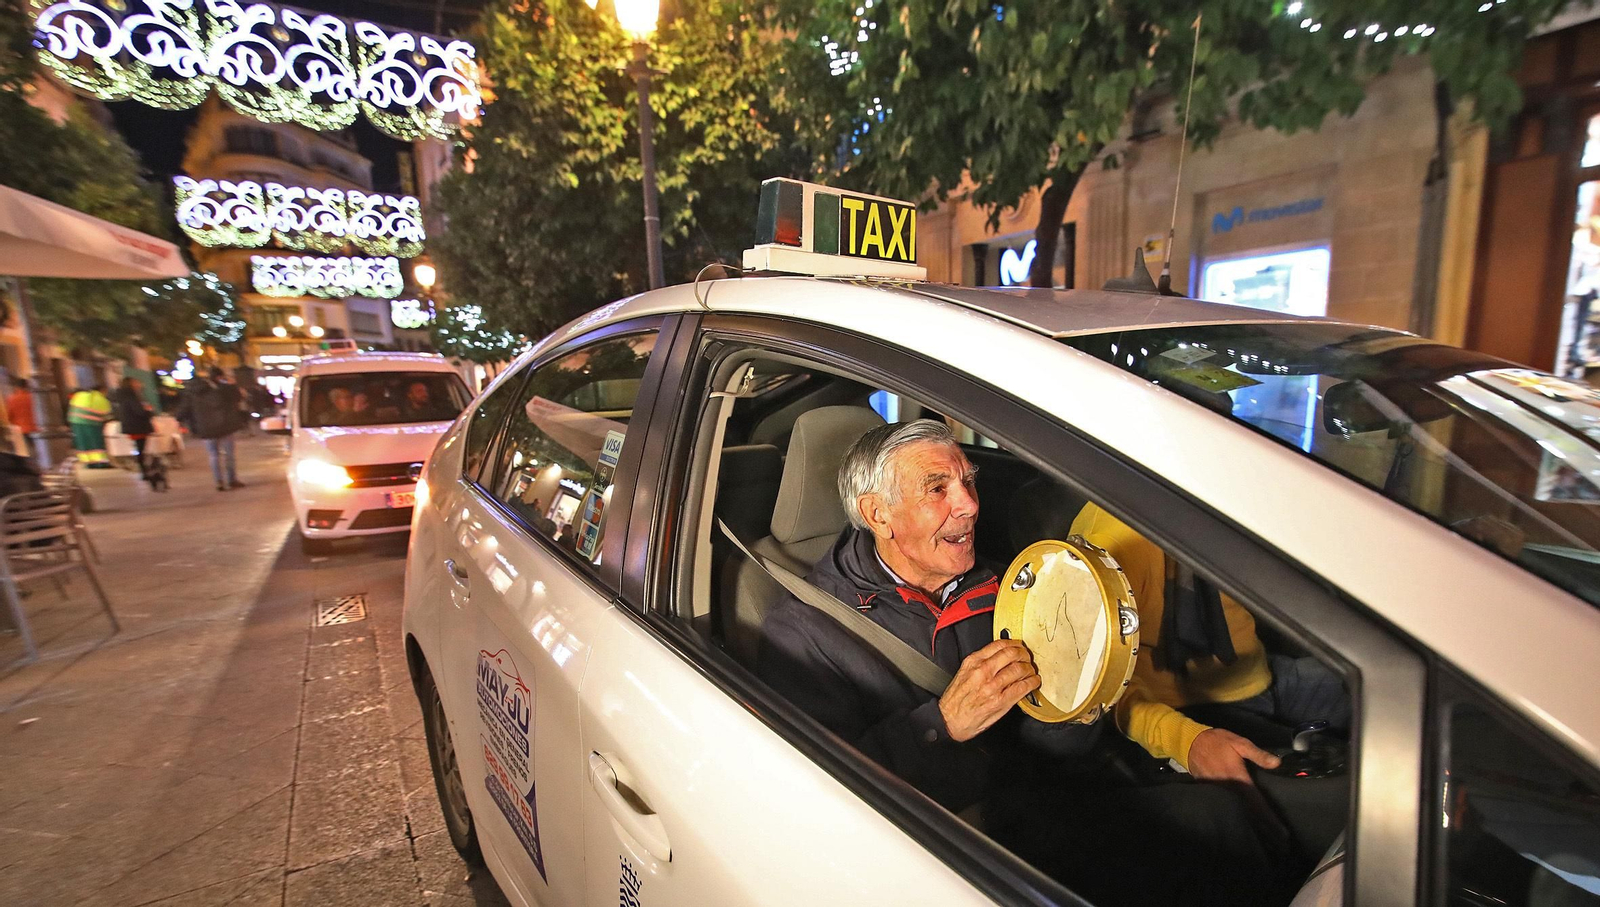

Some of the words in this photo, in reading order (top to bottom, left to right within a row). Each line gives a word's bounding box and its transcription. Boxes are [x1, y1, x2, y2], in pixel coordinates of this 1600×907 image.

[842, 197, 916, 261] TAXI
[605, 438, 621, 454] VISA
[477, 682, 528, 755] AUTOMOCIONES
